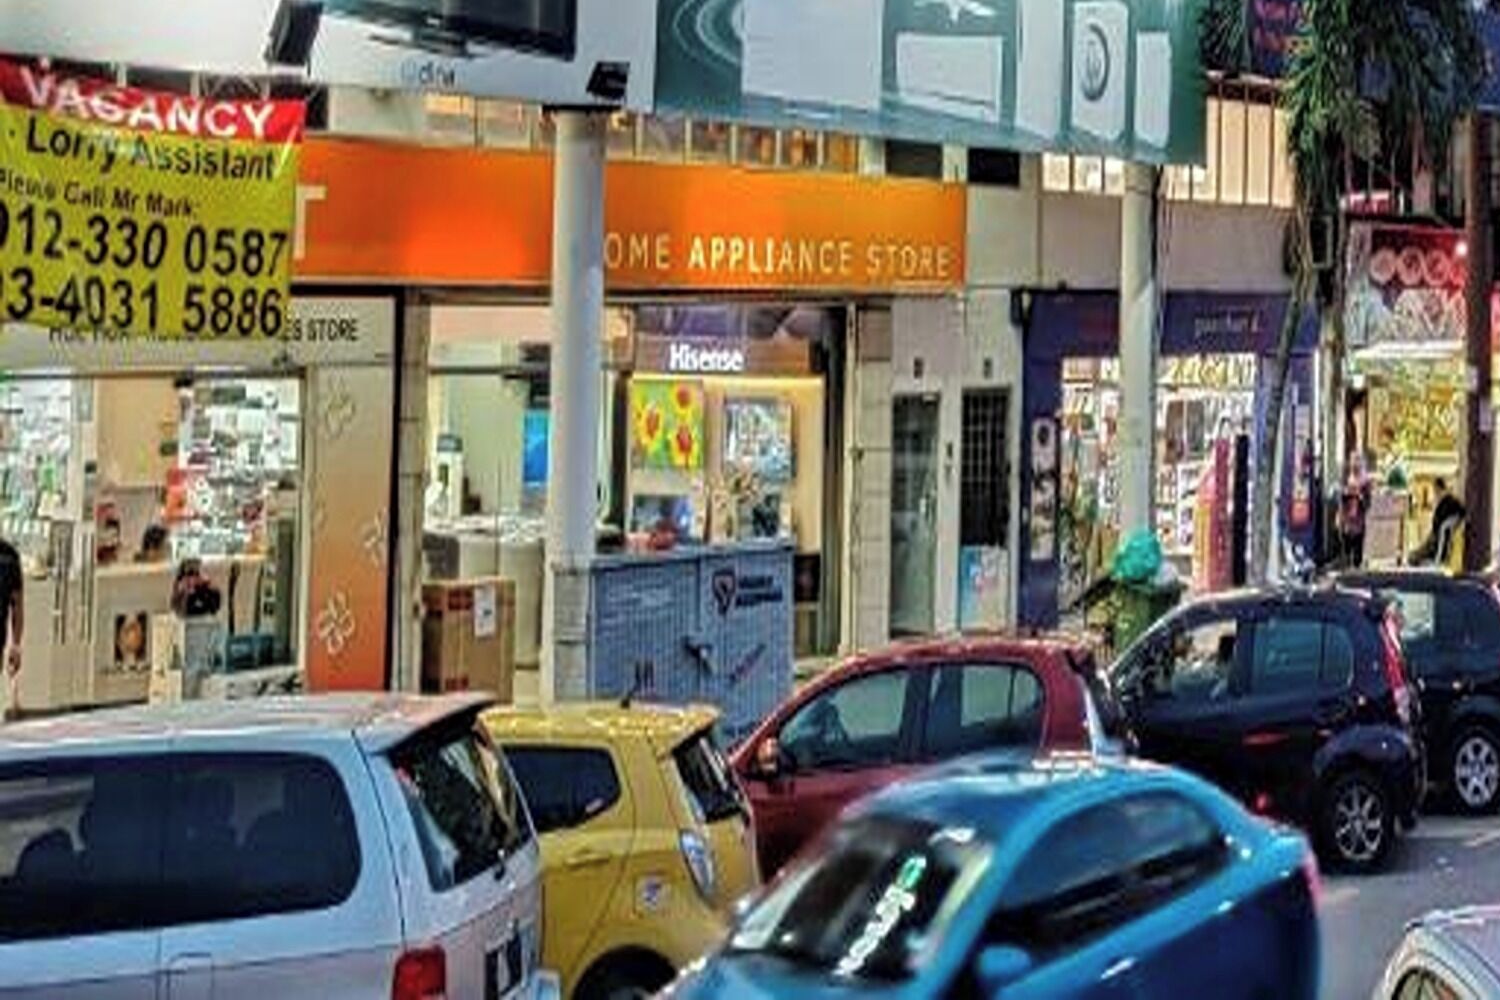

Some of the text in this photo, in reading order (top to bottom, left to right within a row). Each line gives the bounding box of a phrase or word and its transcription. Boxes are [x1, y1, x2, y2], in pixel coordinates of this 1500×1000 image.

[26, 116, 275, 180] Lorry Assistant
[111, 186, 140, 211] Mr
[184, 222, 288, 277] 0587
[603, 232, 951, 278] OME APPLIANCE STORE
[0, 266, 283, 337] 3-4031 5886
[307, 318, 358, 341] STORE
[669, 341, 745, 372] Hisense
